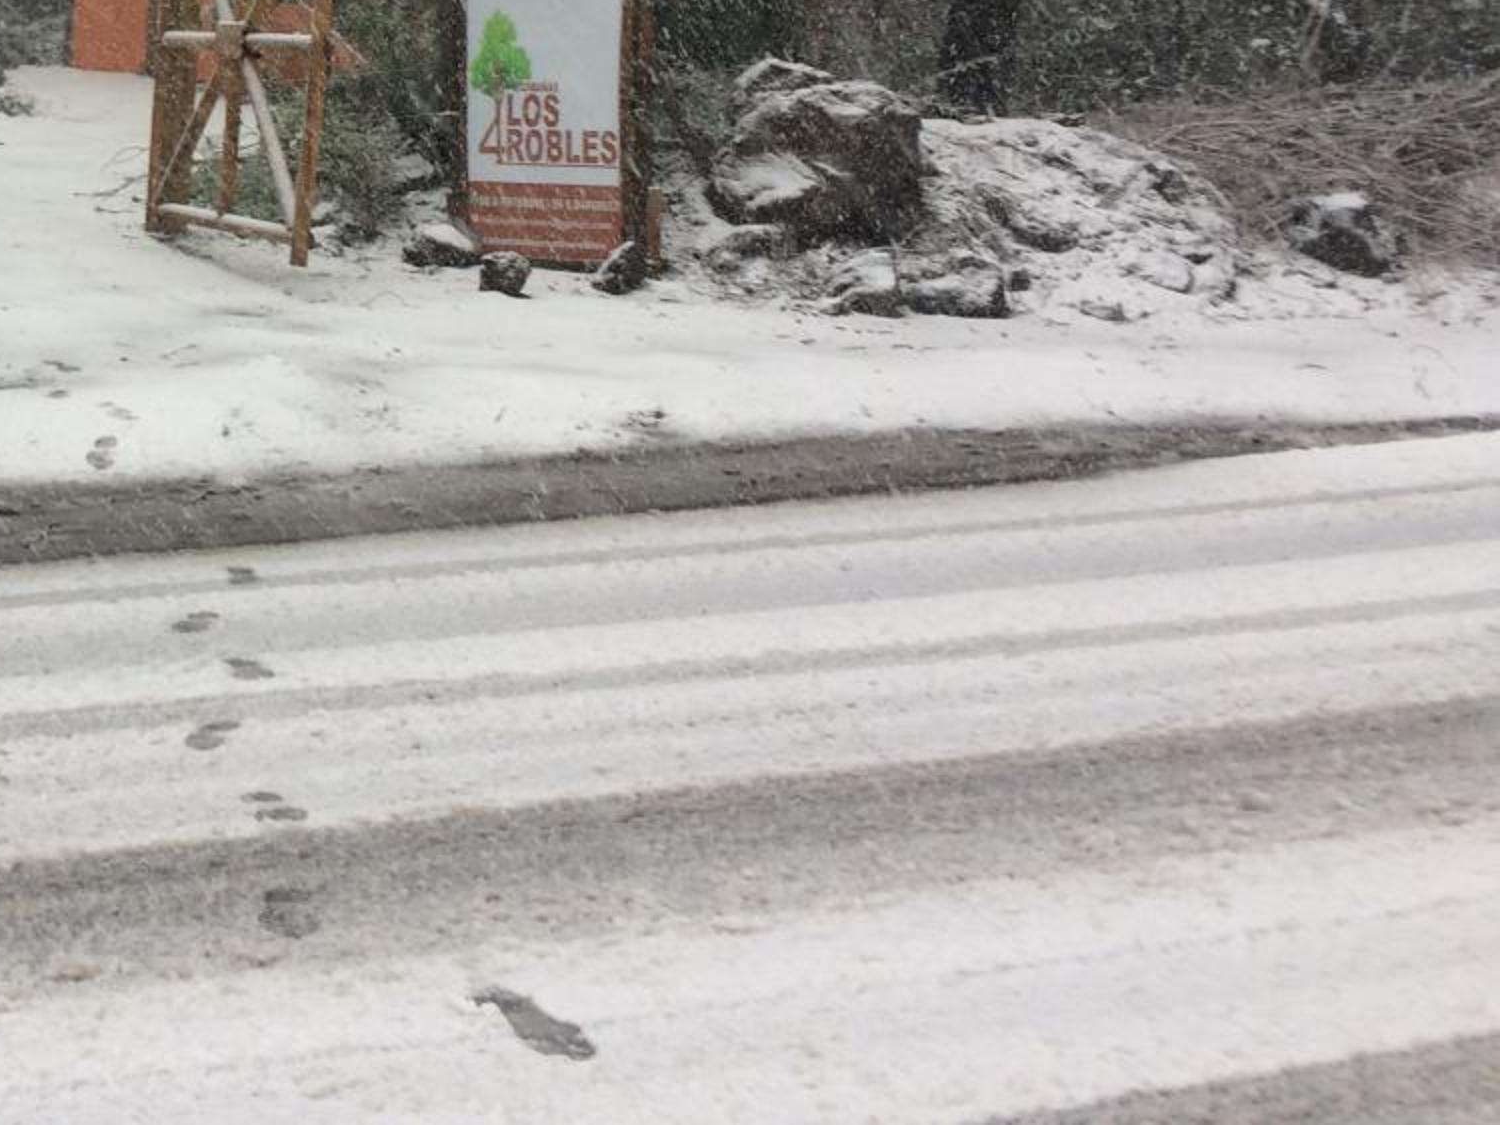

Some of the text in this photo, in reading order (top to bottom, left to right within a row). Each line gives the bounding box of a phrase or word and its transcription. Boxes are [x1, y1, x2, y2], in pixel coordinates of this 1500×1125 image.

[507, 93, 560, 127] LOS
[479, 101, 505, 164] 4
[507, 129, 618, 164] ROBLES
